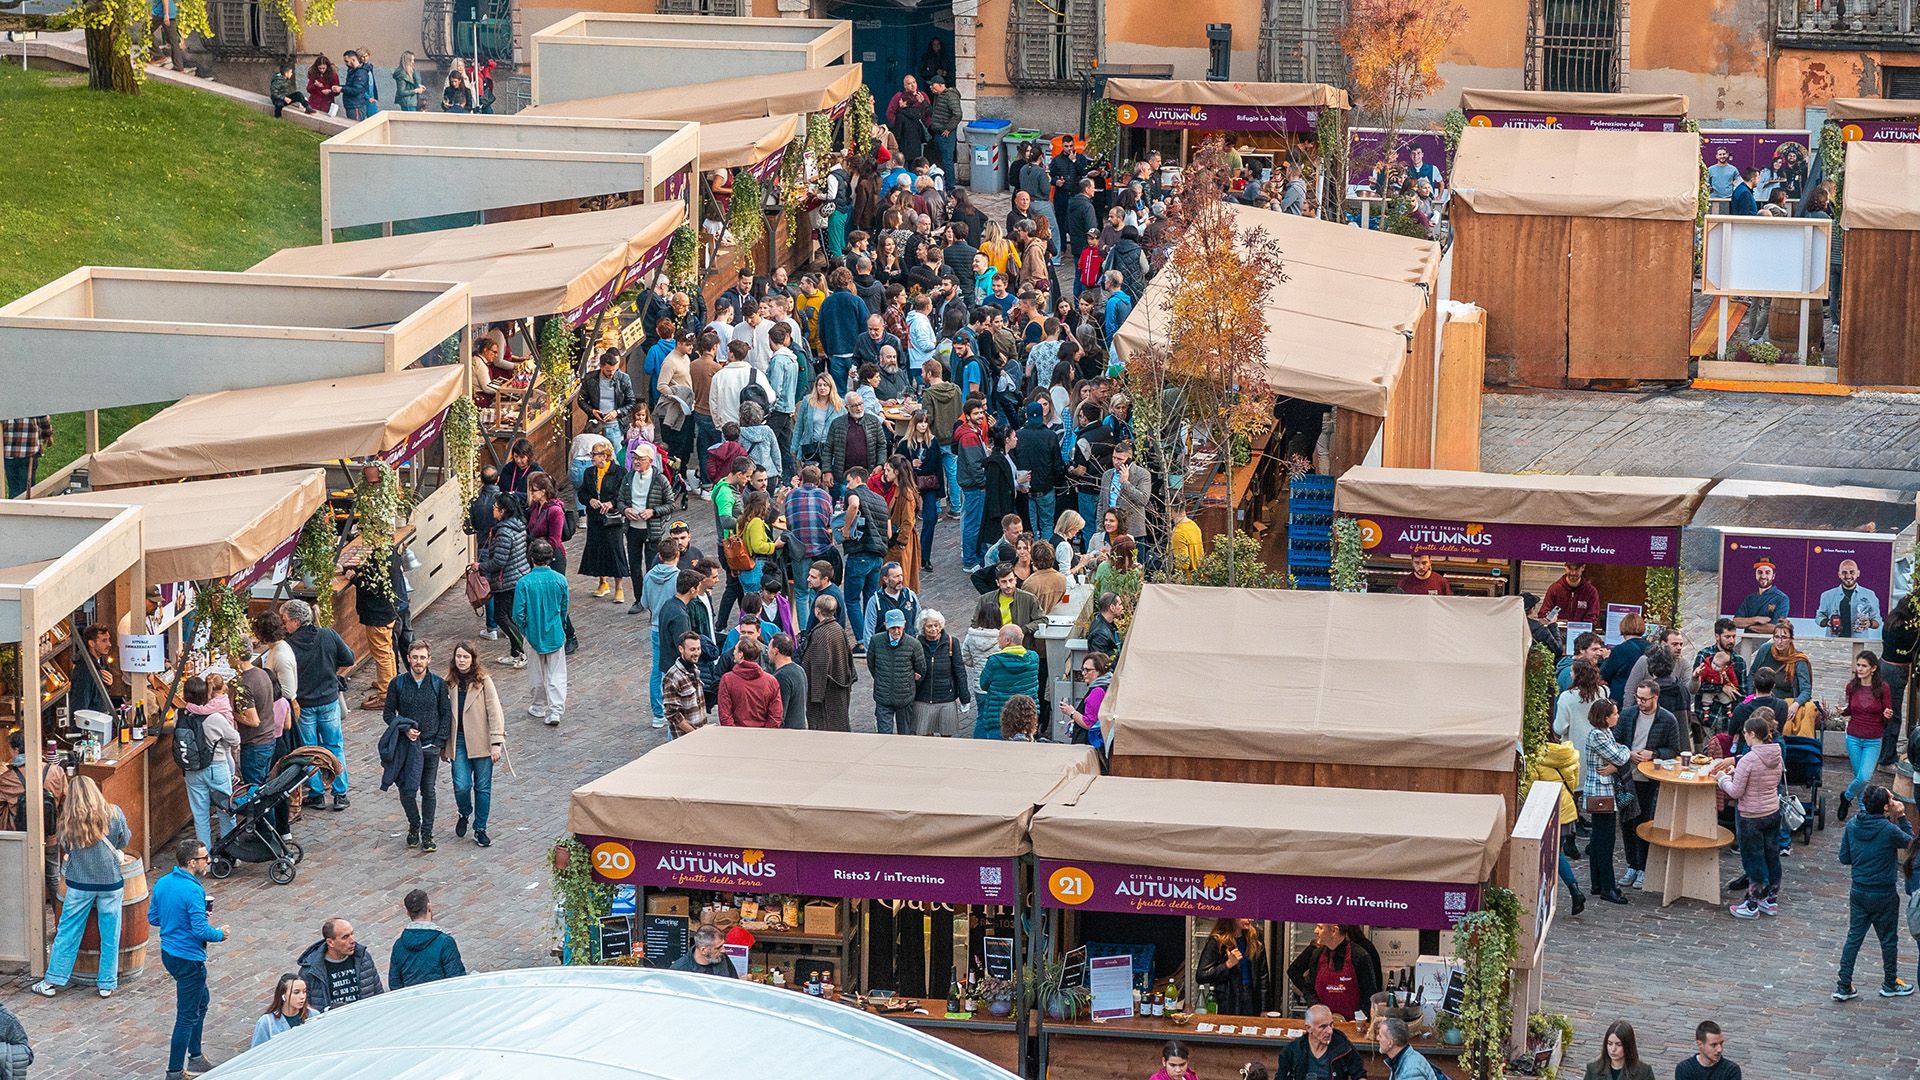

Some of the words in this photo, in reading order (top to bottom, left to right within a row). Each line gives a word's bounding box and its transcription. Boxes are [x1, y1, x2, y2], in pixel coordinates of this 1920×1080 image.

[1124, 110, 1131, 119] 5
[1148, 111, 1207, 121] AUTUMNUS
[1849, 130, 1854, 139] 1
[1873, 131, 1920, 139] AUTUMN
[1362, 527, 1374, 542] 2
[1398, 530, 1492, 545] AUTUMNUS
[1567, 535, 1590, 544] Twist
[1414, 544, 1438, 553] frutti
[1569, 545, 1588, 553] and
[1590, 546, 1616, 554] More
[596, 851, 630, 870] 20
[656, 856, 777, 878] AUTUMNUS
[678, 874, 707, 885] frutti
[710, 876, 735, 885] della
[738, 878, 763, 887] terra
[833, 869, 870, 881] Risto3
[874, 871, 880, 881] /
[884, 872, 945, 884] inTrentino
[1059, 877, 1081, 896] 21
[1115, 880, 1237, 902] AUTUMNUS
[1136, 899, 1166, 910] frutti
[1169, 900, 1194, 909] della
[1197, 902, 1223, 911] terra
[1295, 894, 1333, 905] Risto3
[1336, 896, 1343, 906] /
[1346, 897, 1408, 910] inTrentino
[655, 918, 679, 926] Catering
